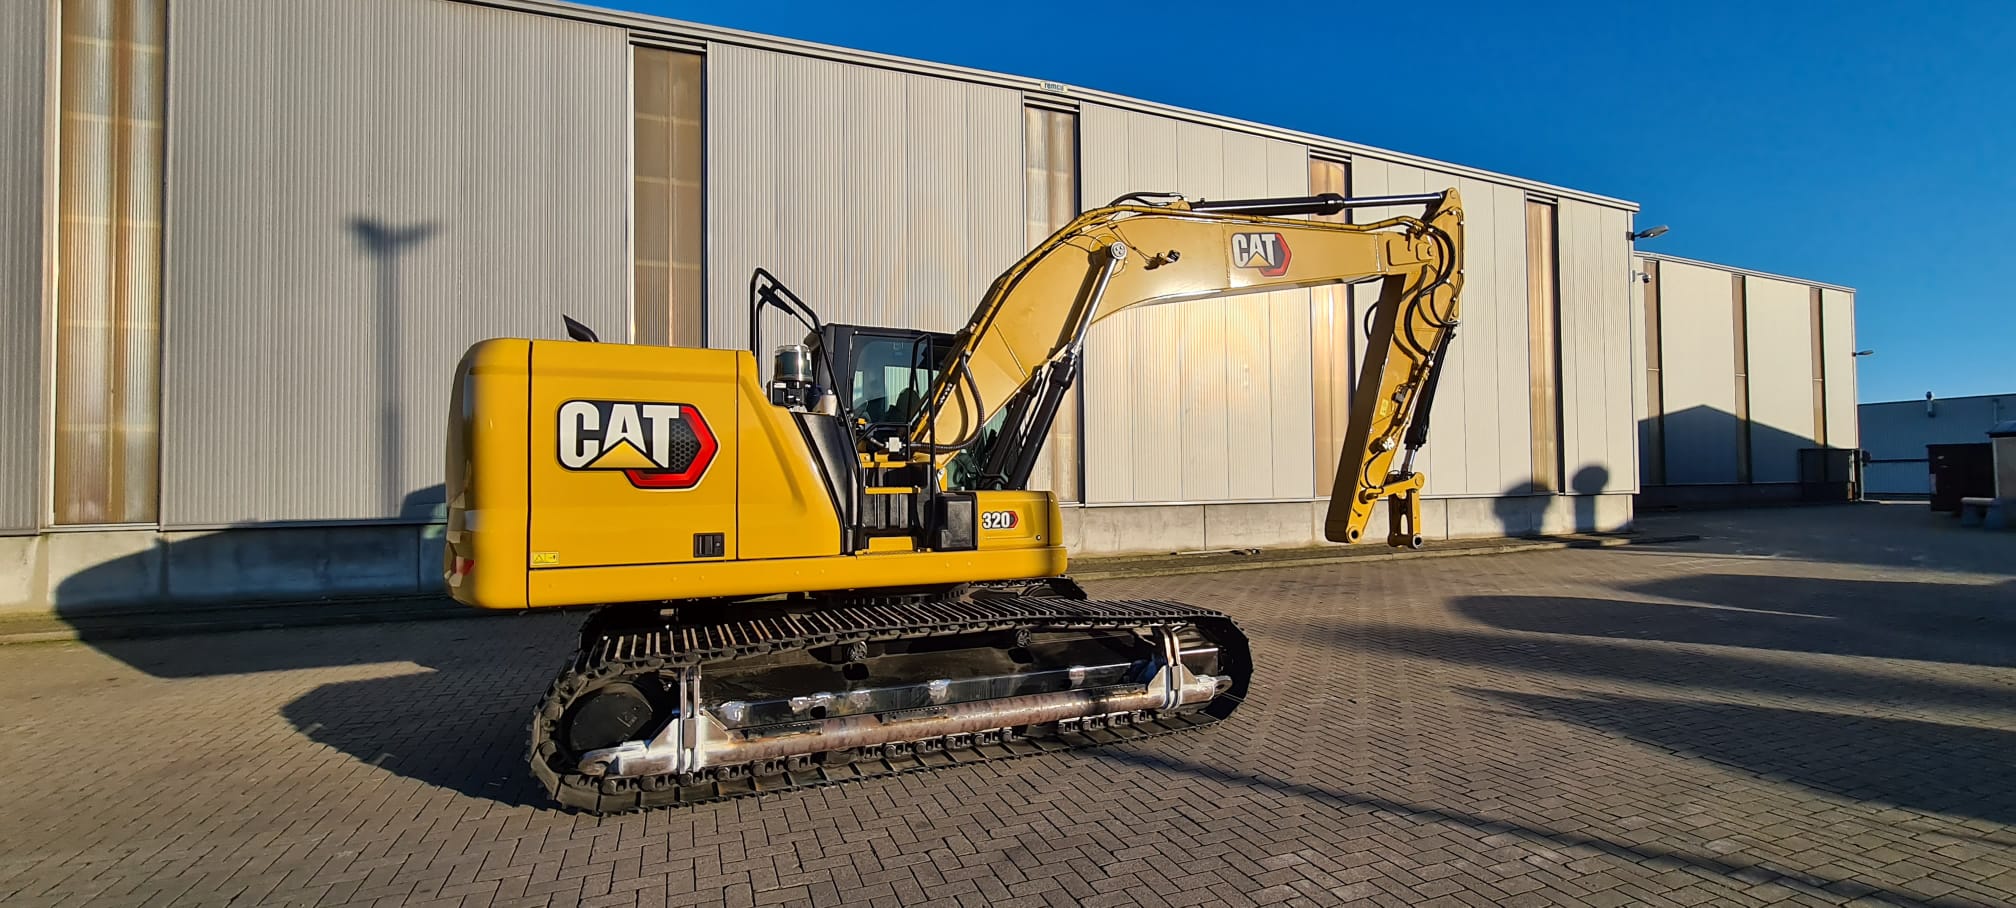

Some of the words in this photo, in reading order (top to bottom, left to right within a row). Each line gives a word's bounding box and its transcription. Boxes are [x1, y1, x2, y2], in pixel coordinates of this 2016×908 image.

[1232, 233, 1276, 268] CAT
[559, 401, 680, 468] CAT
[982, 511, 1010, 529] 320
